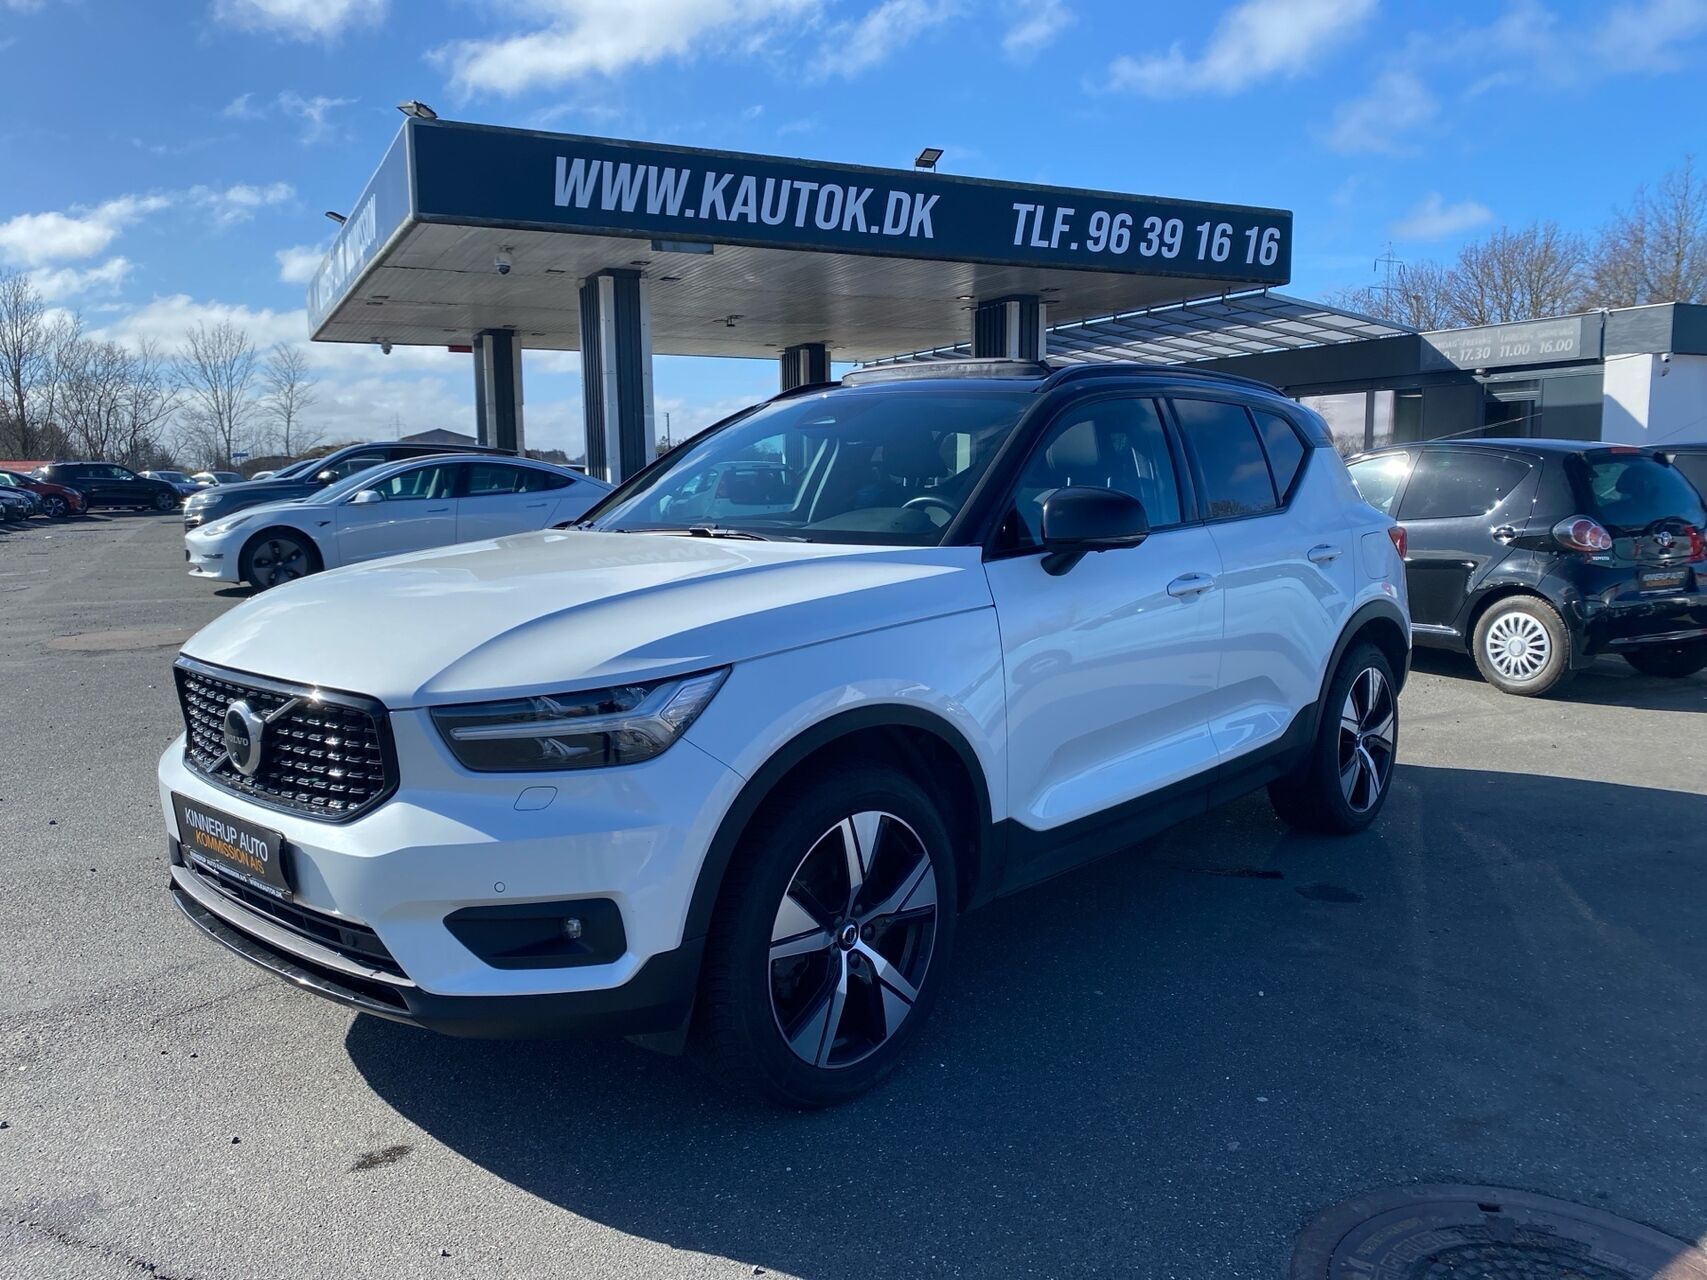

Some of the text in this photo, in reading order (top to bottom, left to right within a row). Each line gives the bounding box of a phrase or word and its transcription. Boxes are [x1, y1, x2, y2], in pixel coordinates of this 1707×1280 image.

[554, 156, 940, 239] WWW.KAUTOK.DK
[1012, 203, 1281, 266] TLF. 96 39 16 16
[1458, 347, 1491, 362] 17.30
[1499, 338, 1574, 358] 11.00 16.00
[184, 807, 268, 862] KINNERUP AUTO
[195, 830, 249, 866] KOMMISSION
